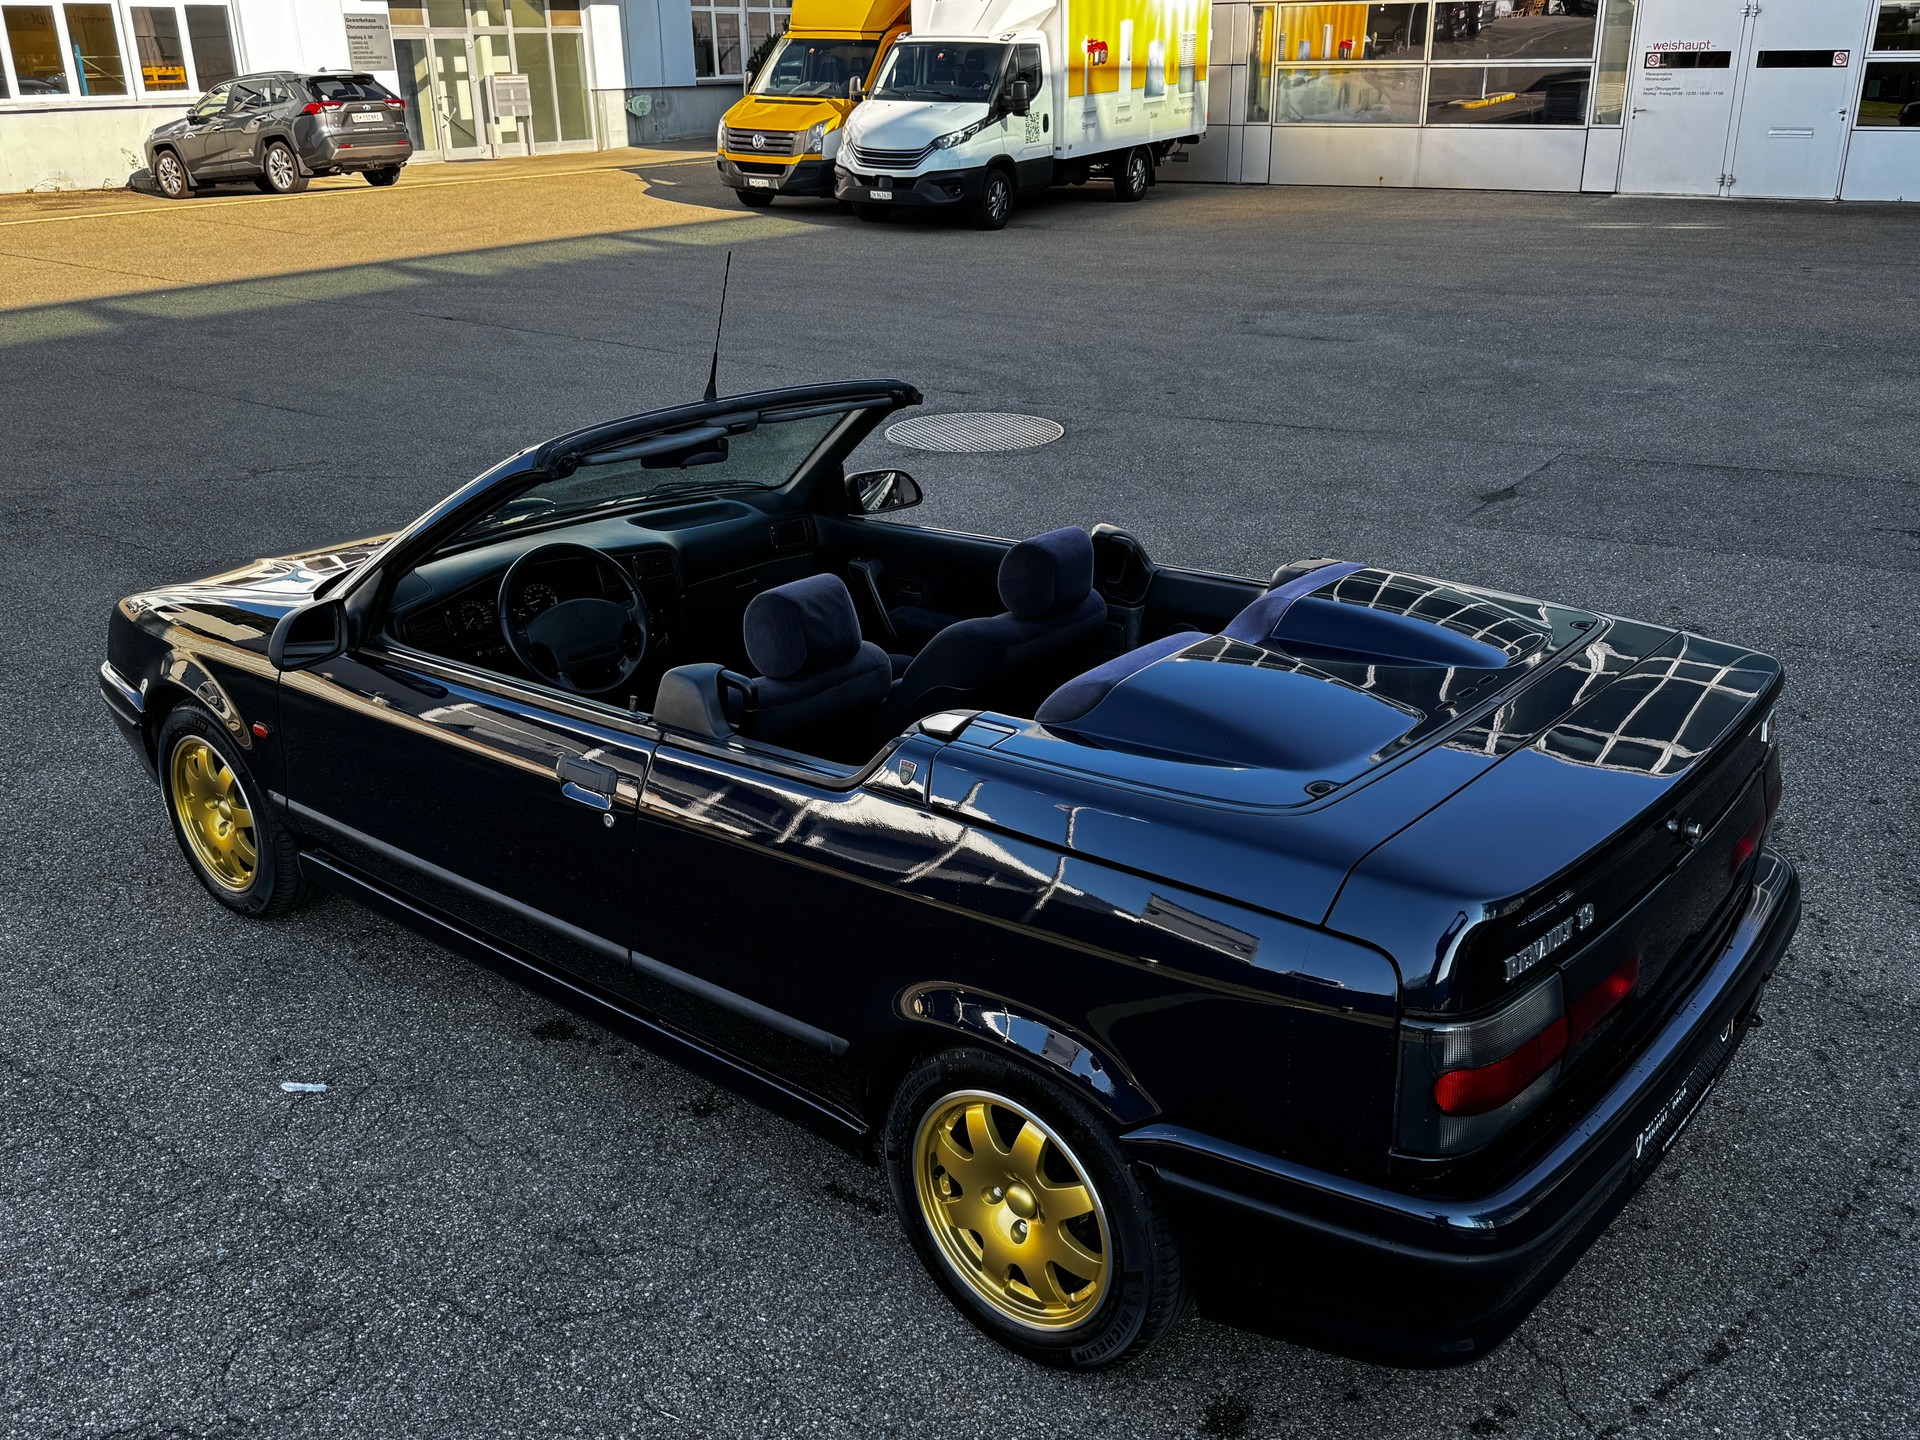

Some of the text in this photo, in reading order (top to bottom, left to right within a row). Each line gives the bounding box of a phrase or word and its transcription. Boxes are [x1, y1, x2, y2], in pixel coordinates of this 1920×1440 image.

[1504, 902, 1595, 983] RENAULT 19
[1644, 1110, 1668, 1145] RENAULT
[1075, 1307, 1134, 1363] MICHELIN
